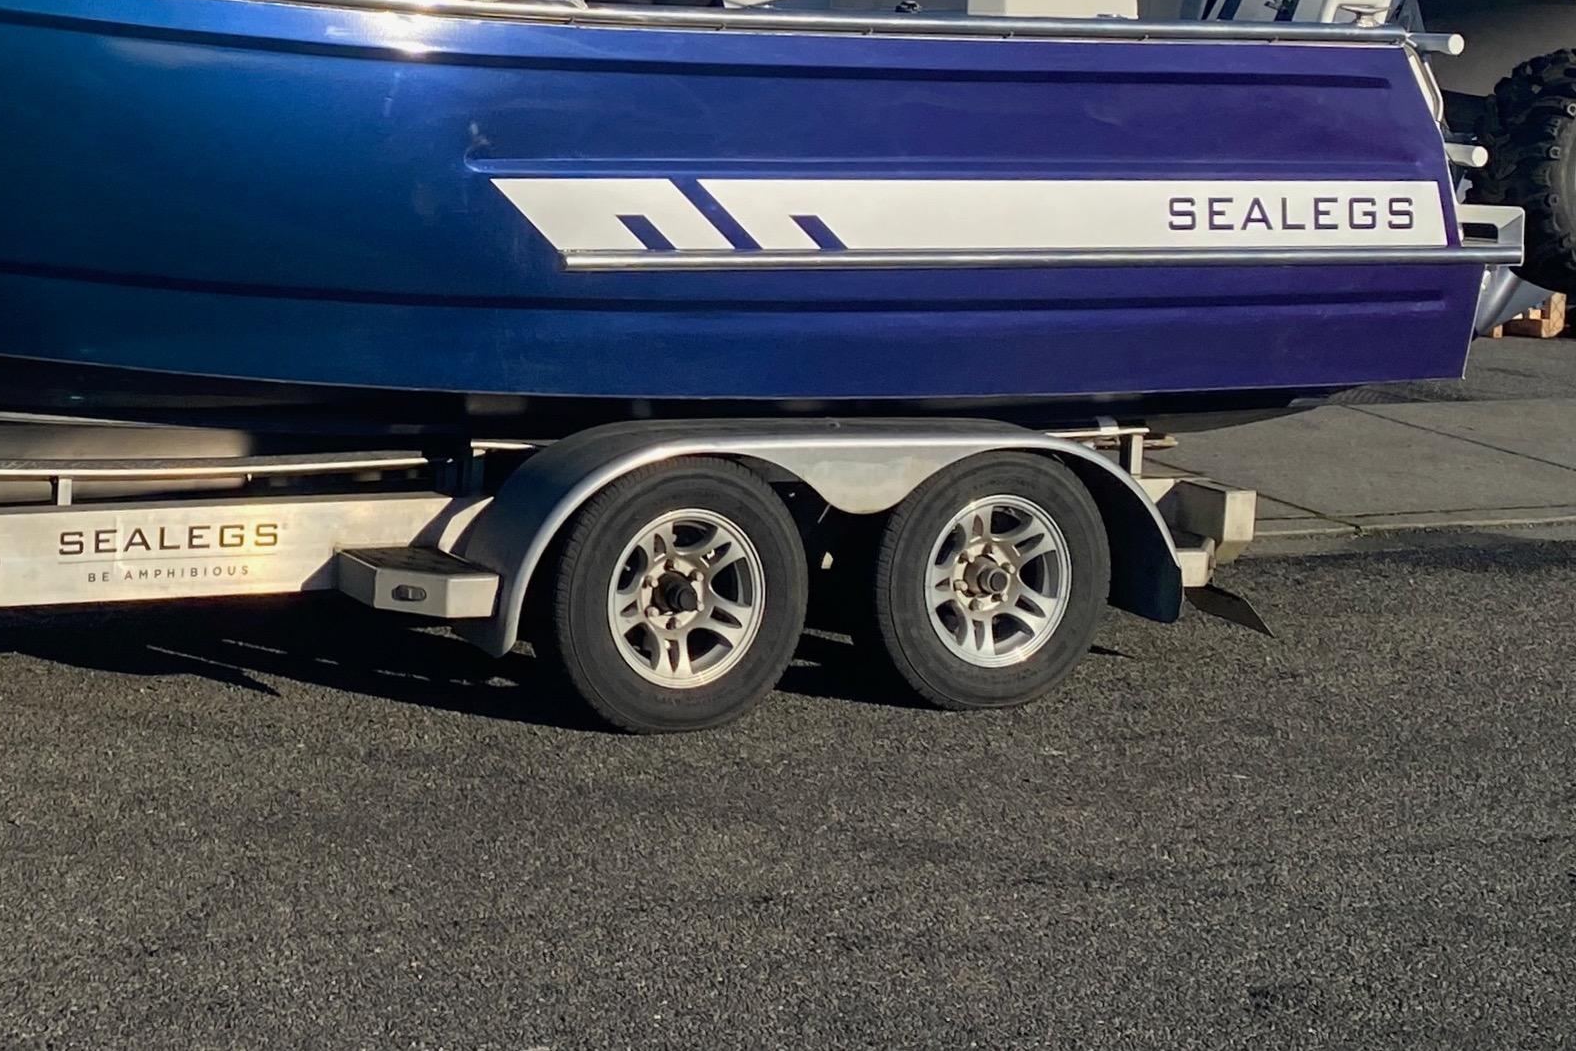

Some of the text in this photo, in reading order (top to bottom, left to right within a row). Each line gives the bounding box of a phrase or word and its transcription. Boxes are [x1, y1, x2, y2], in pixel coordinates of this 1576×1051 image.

[1168, 196, 1414, 231] SEALEGS
[58, 523, 279, 556] SEALEGS
[88, 565, 250, 583] BE AMPHIBIOUS
